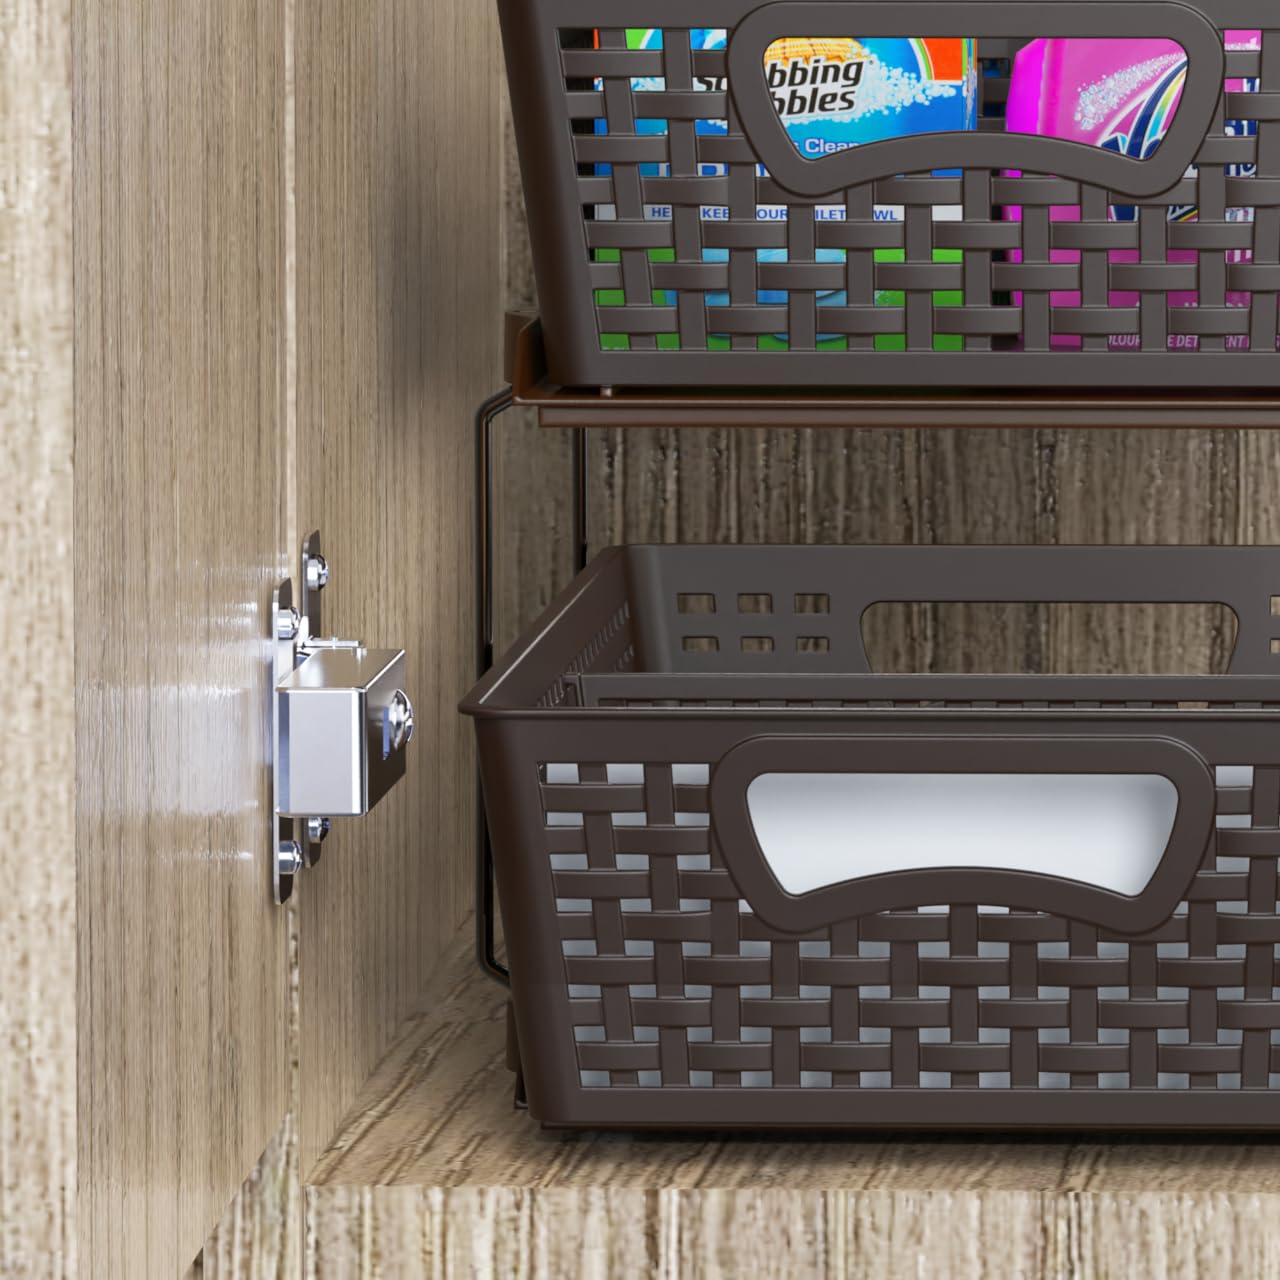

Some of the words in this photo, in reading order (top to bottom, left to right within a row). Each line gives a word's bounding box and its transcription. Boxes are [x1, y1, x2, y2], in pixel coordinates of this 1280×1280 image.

[805, 138, 862, 154] Clea
[756, 207, 788, 220] OUR
[815, 207, 846, 220] ILET
[873, 208, 897, 220] WL
